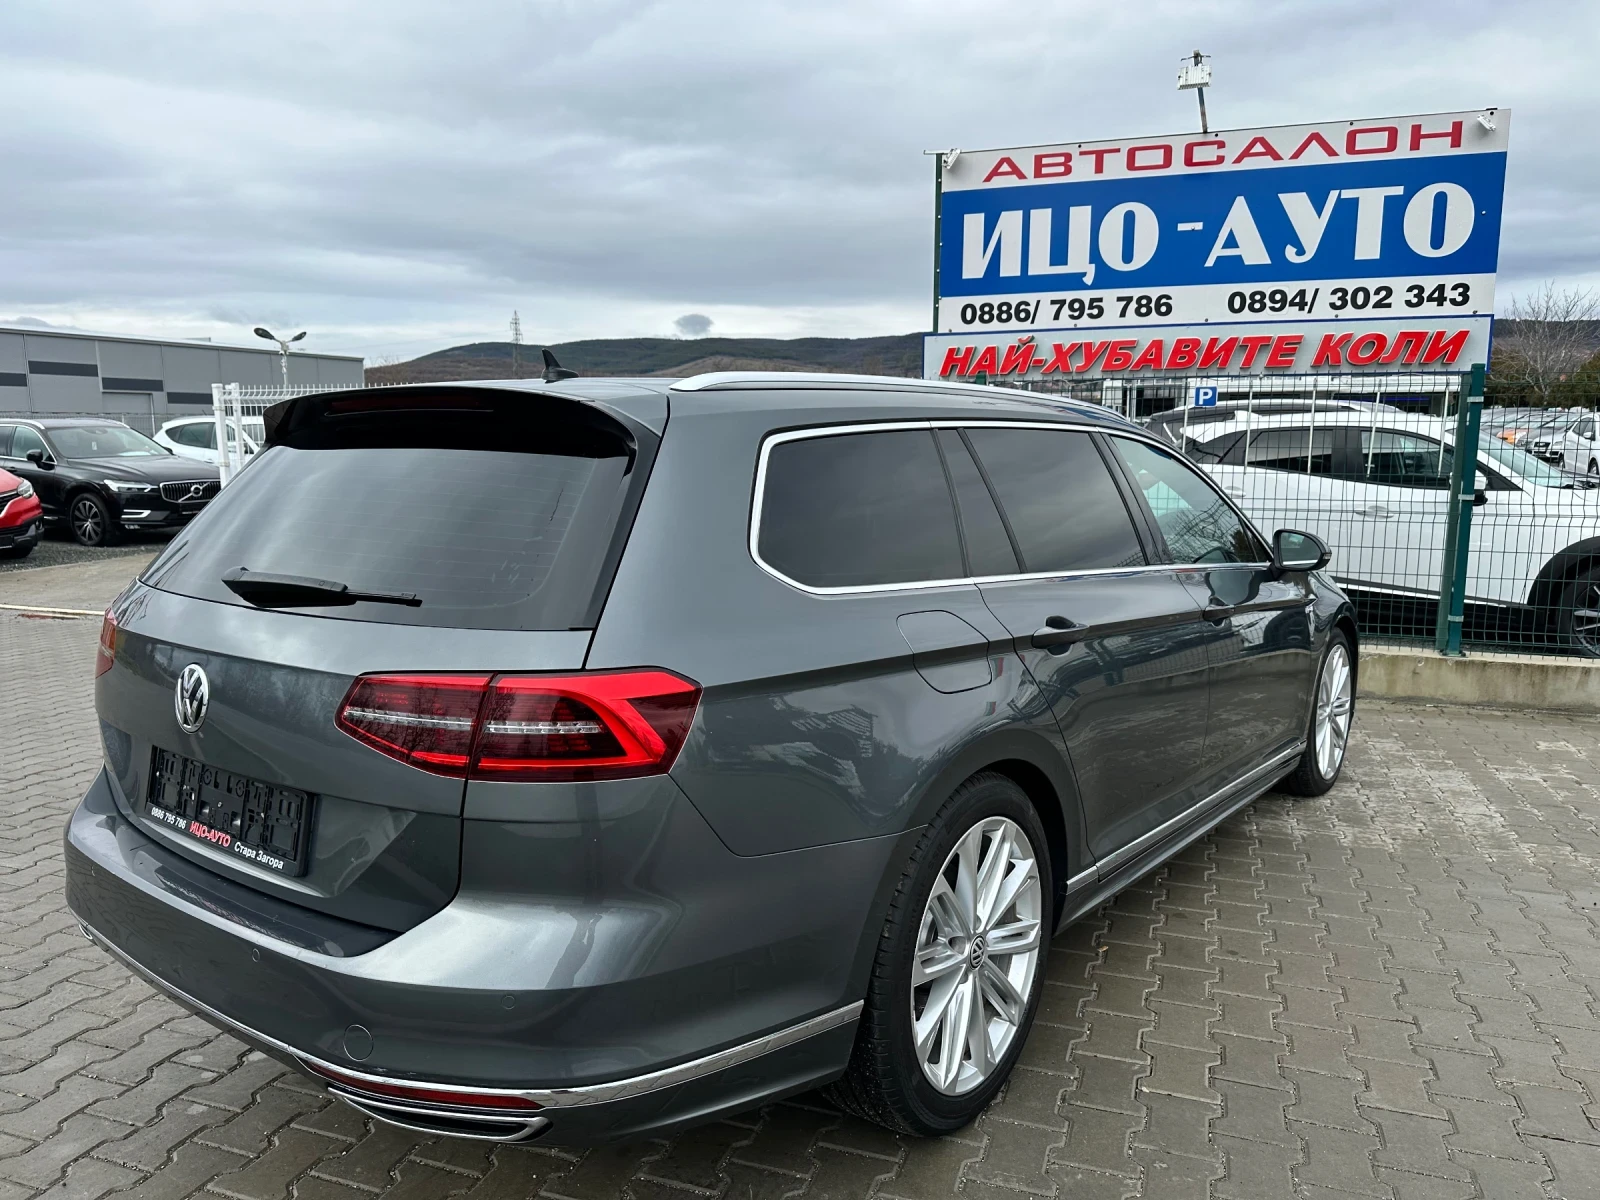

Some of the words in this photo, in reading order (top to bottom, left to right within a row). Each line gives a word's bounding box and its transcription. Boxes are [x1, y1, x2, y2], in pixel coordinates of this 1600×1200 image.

[983, 121, 1463, 183] АВТОСАЛОН
[960, 300, 1041, 325] 0886/
[1050, 297, 1104, 321] 795
[1116, 294, 1173, 319] 786
[1227, 287, 1320, 314] 0894/
[1328, 285, 1393, 311] 302
[1404, 282, 1471, 308] 343
[938, 333, 1305, 377] НАЙ-ХУБАВИТЕ
[1310, 329, 1471, 367] КОЛИ
[1199, 388, 1213, 405] P
[151, 807, 164, 819] 0886
[164, 812, 175, 825] 795
[176, 817, 186, 829] 786
[189, 821, 230, 847] ИЦО-АУТО
[234, 842, 256, 858] Стара
[256, 851, 284, 869] Загора
